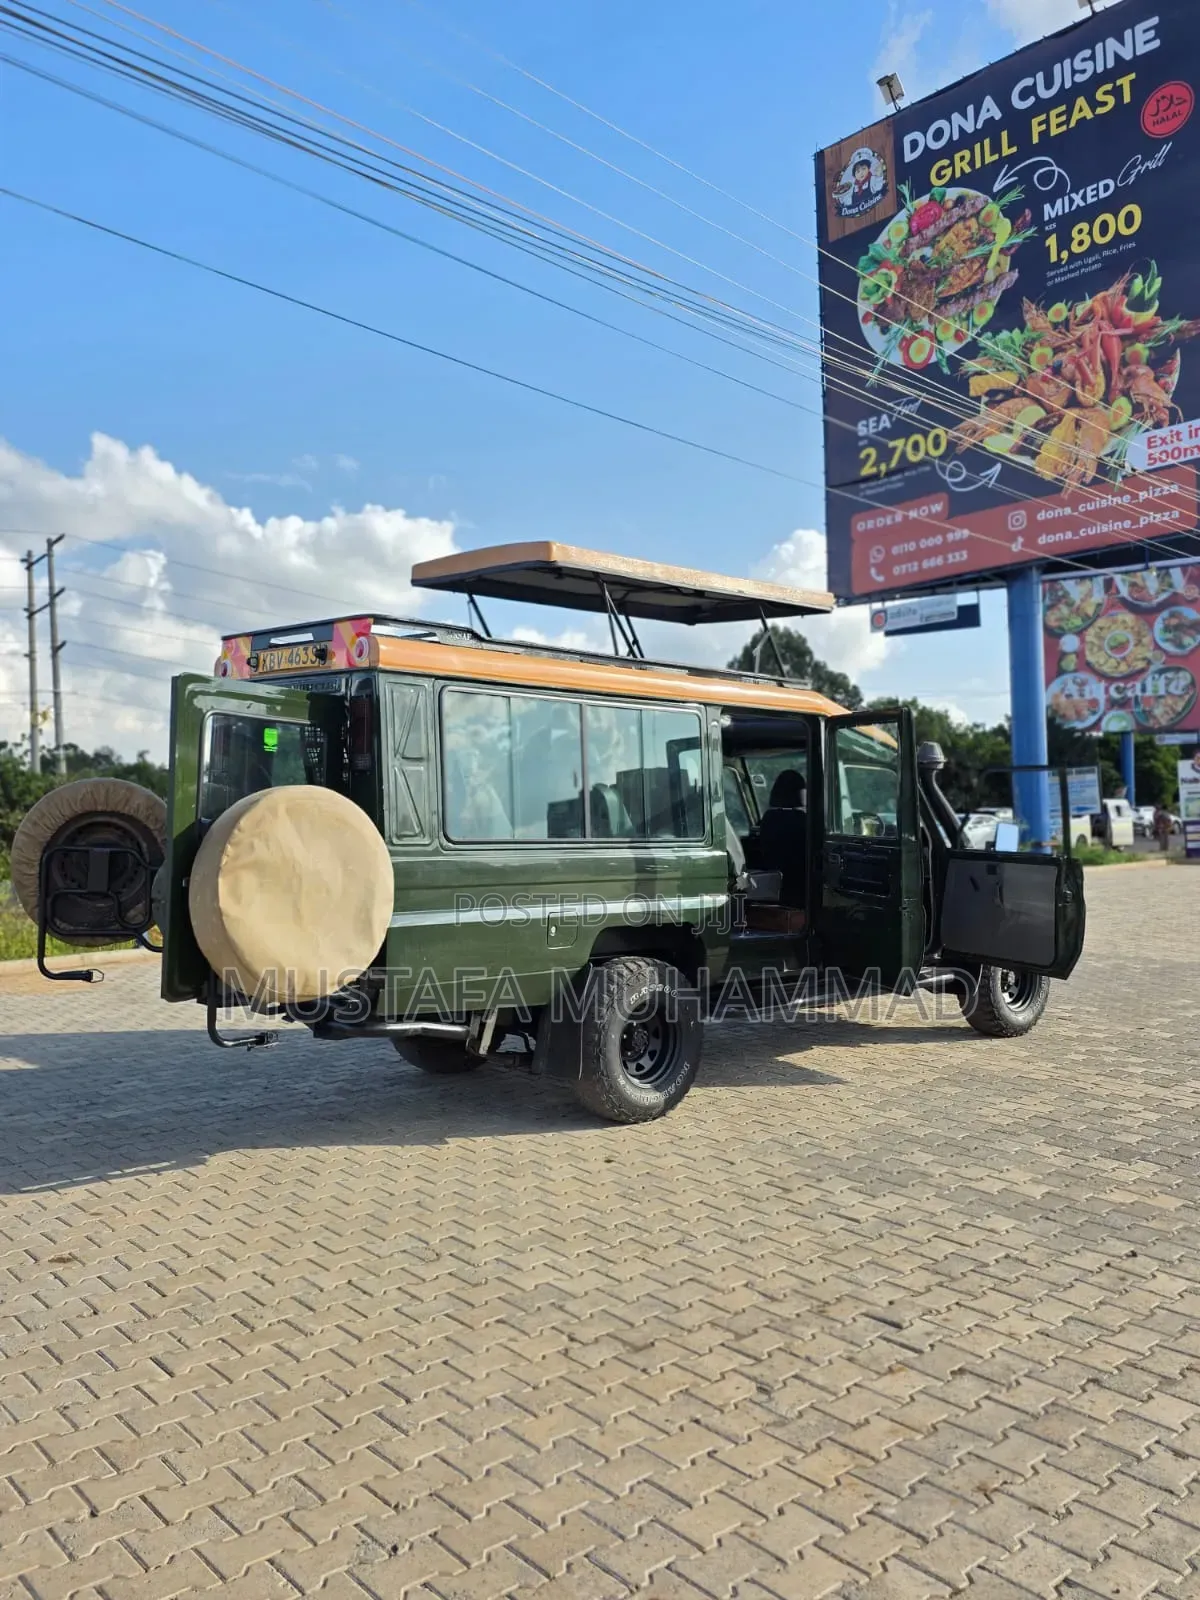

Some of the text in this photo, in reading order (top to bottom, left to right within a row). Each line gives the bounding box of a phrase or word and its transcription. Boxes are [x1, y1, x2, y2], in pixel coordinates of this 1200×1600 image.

[903, 16, 1160, 163] DONA CUISINE
[929, 72, 1137, 187] GRILL FEAST
[1152, 109, 1183, 128] HALAL
[1043, 141, 1173, 222] MIXED Grill
[841, 193, 883, 216] Dona Cuisine
[1044, 203, 1142, 265] 1,800
[1046, 263, 1068, 278] Served
[1119, 241, 1137, 252] Fries
[1054, 270, 1080, 284] Mashed
[1080, 262, 1102, 275] Potato
[857, 413, 892, 437] SEA
[1147, 429, 1183, 450] Exit
[859, 427, 948, 478] 2,700
[856, 501, 944, 532] ORDER NOW
[1036, 482, 1180, 521] dona_cuisine_pizza
[1037, 509, 1180, 545] dona_cuisine_pizza
[262, 650, 284, 673] KBV
